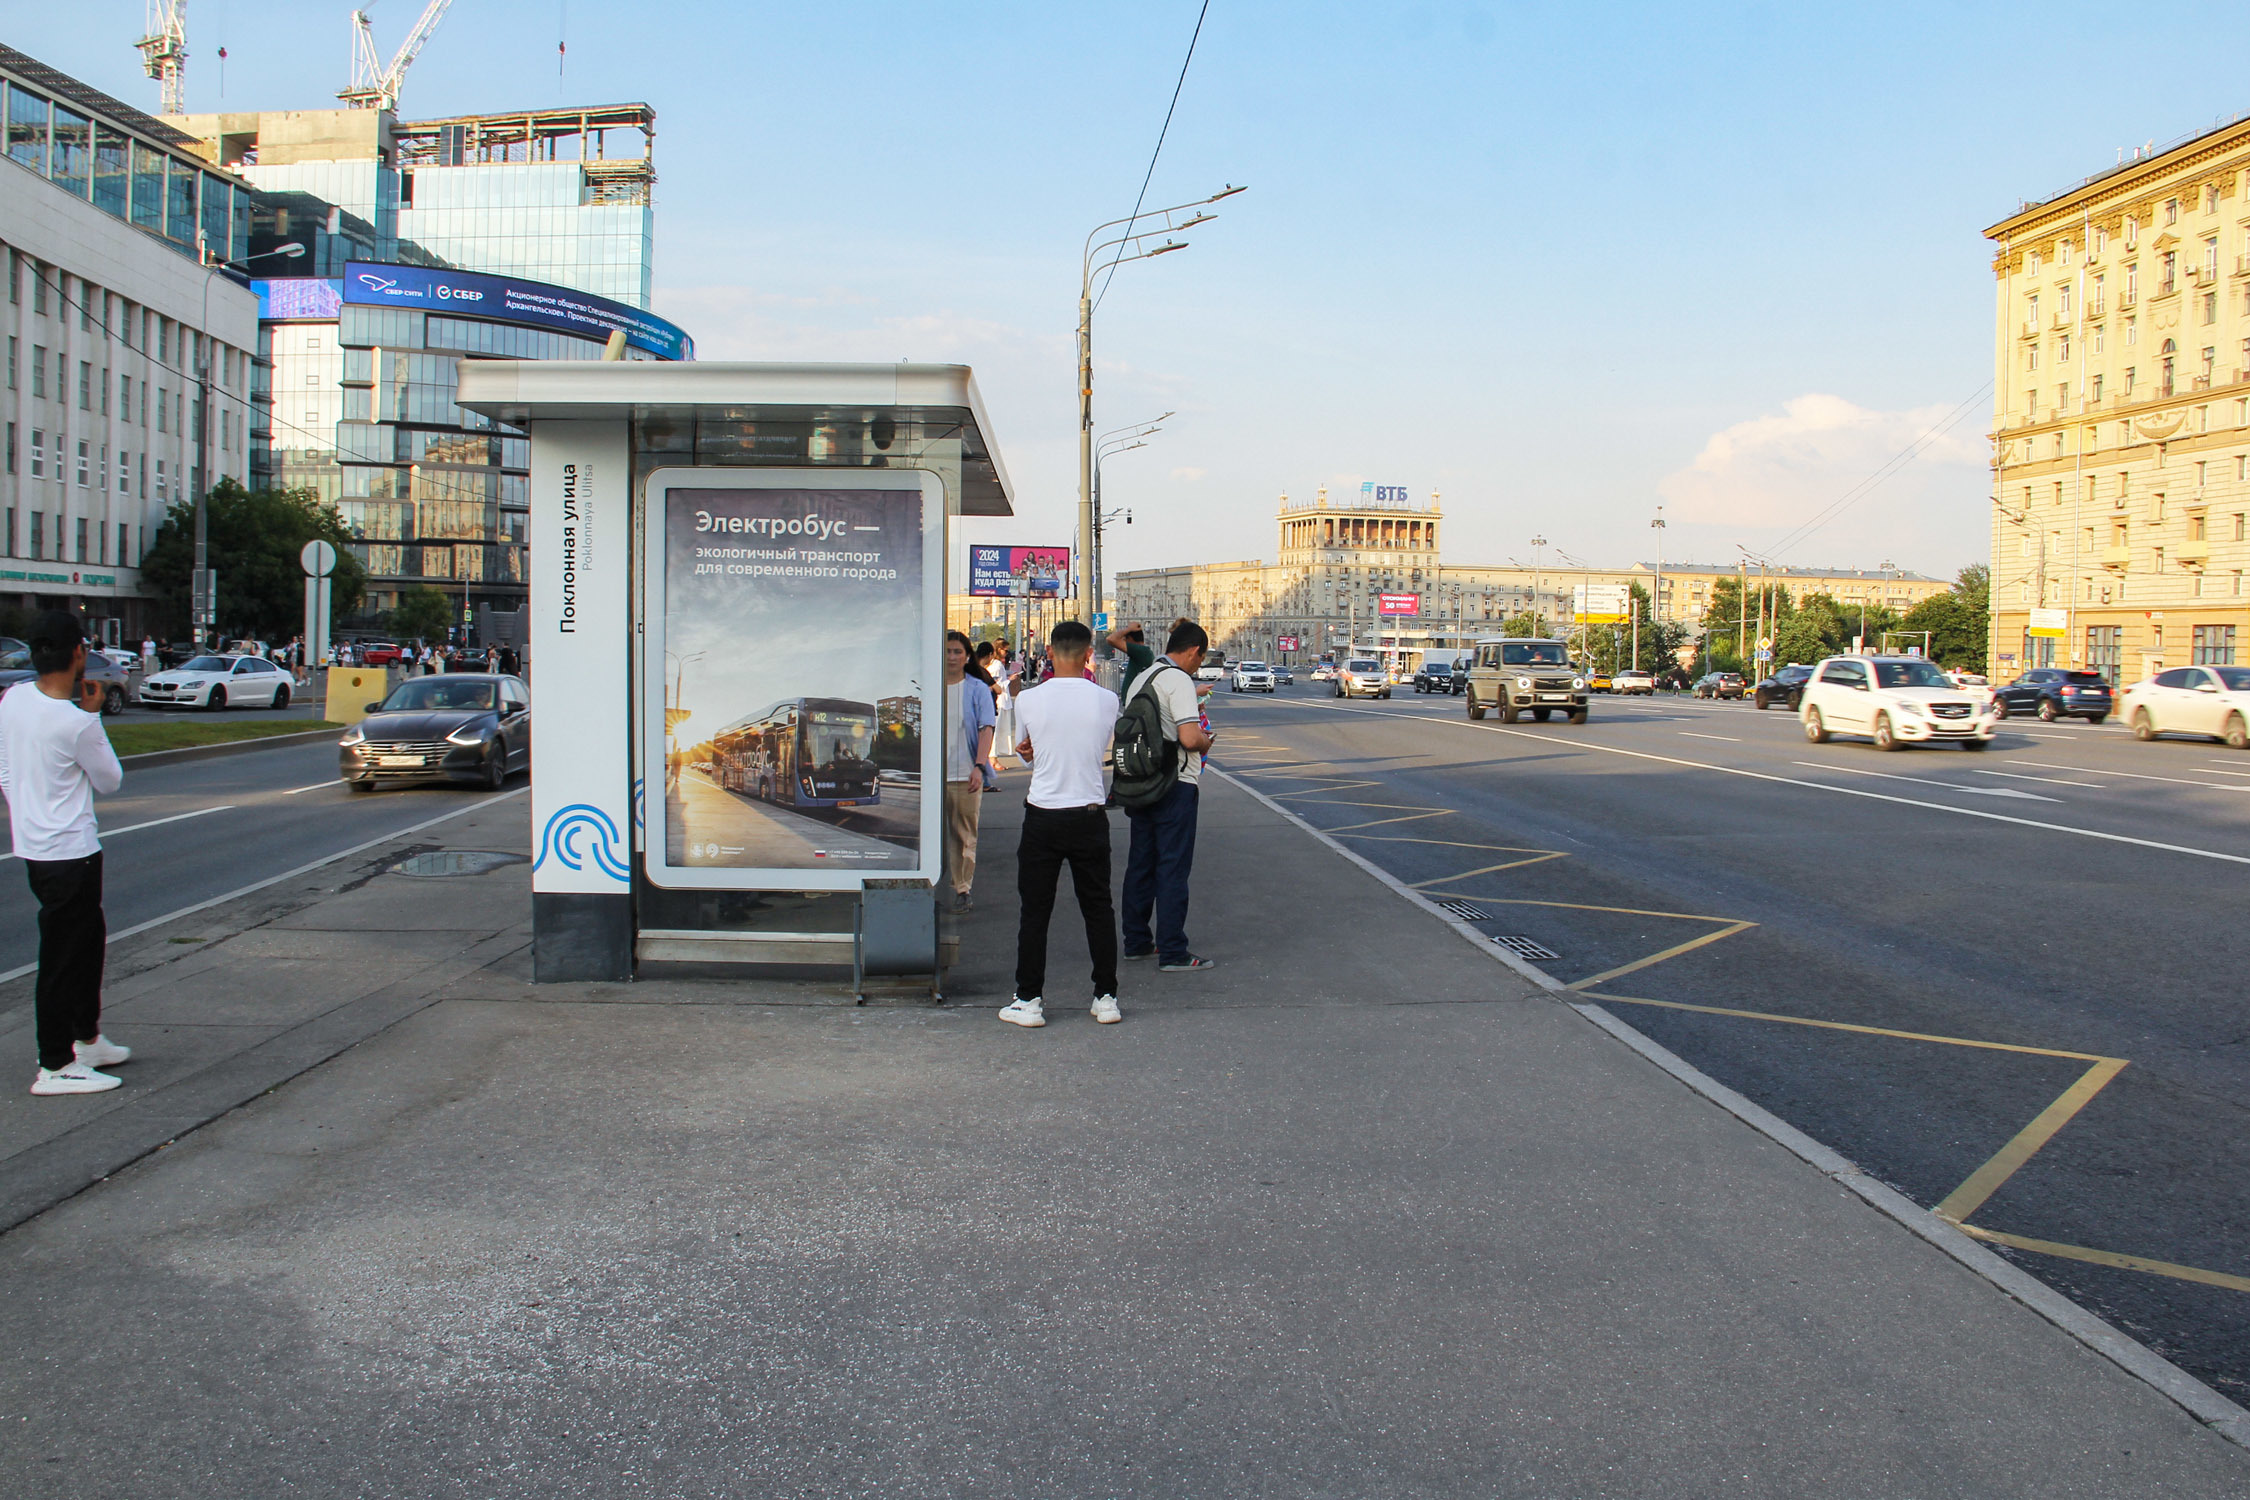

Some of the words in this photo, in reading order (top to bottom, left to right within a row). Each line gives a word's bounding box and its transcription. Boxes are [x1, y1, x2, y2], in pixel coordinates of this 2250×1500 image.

[453, 289, 483, 301] СБЕР
[582, 464, 593, 498] Ulitsa
[563, 464, 578, 521] улица
[1376, 486, 1408, 501] ВТБ
[695, 510, 847, 541] Электробус
[582, 502, 594, 571] Poklonnaya
[695, 547, 797, 561] экологичный
[800, 550, 881, 565] транспорт
[979, 549, 1000, 561] 2024
[560, 527, 576, 633] Поклонная
[695, 563, 723, 576] для
[727, 563, 839, 578] современного
[842, 567, 897, 581] города
[975, 568, 992, 578] Нам
[993, 570, 1011, 578] есть
[974, 578, 995, 587] куда
[996, 579, 1019, 588] расти
